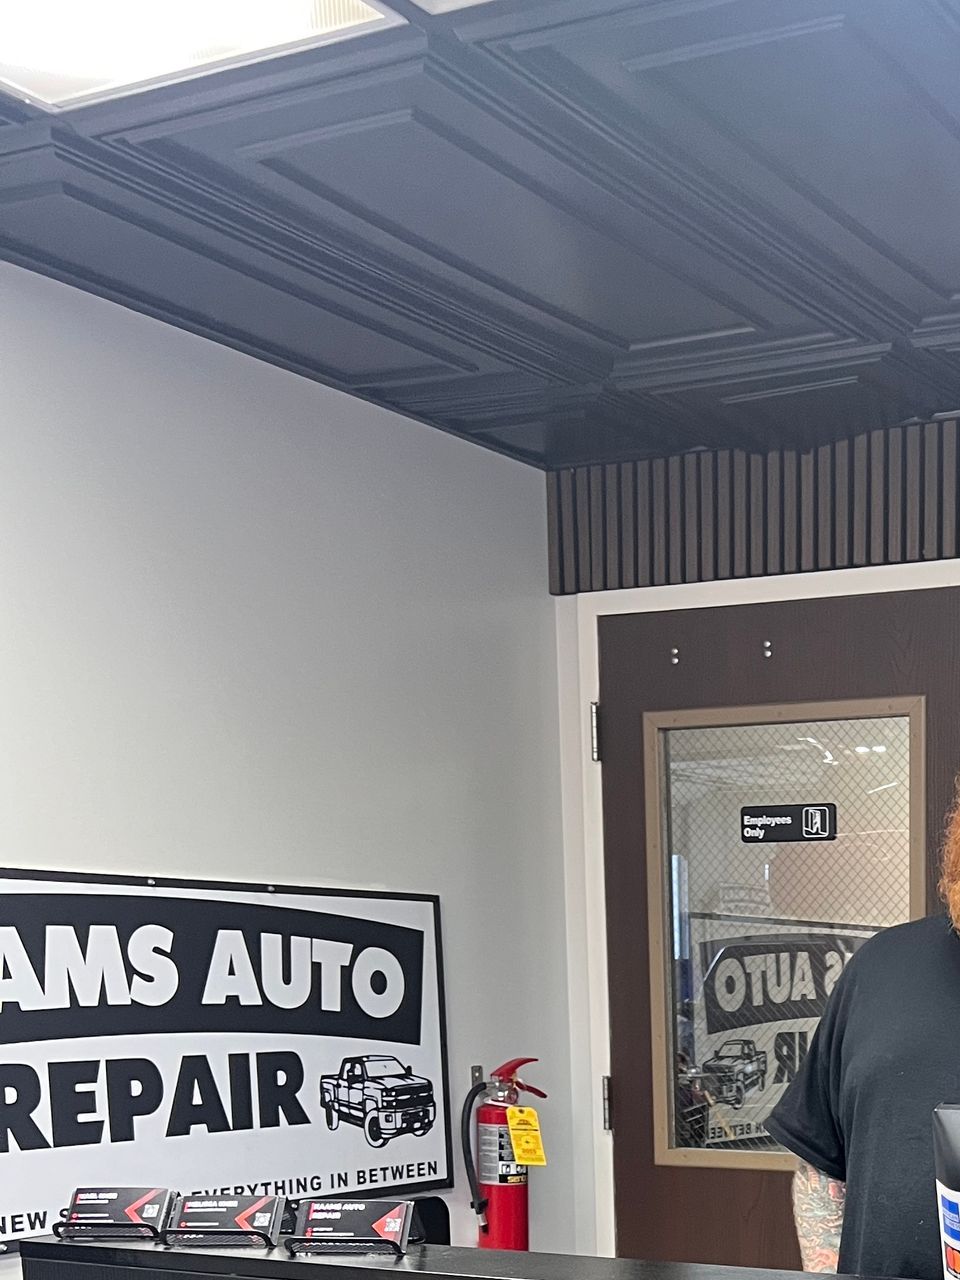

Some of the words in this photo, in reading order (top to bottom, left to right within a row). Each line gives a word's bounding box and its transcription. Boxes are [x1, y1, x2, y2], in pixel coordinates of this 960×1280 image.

[744, 815, 792, 826] Employees
[744, 827, 765, 839] Only
[201, 929, 405, 1018] AUTO
[0, 1051, 311, 1153] REPAIR
[191, 1176, 322, 1197] RYTHING
[330, 1172, 348, 1189] IN
[357, 1161, 438, 1185] BETWEEN
